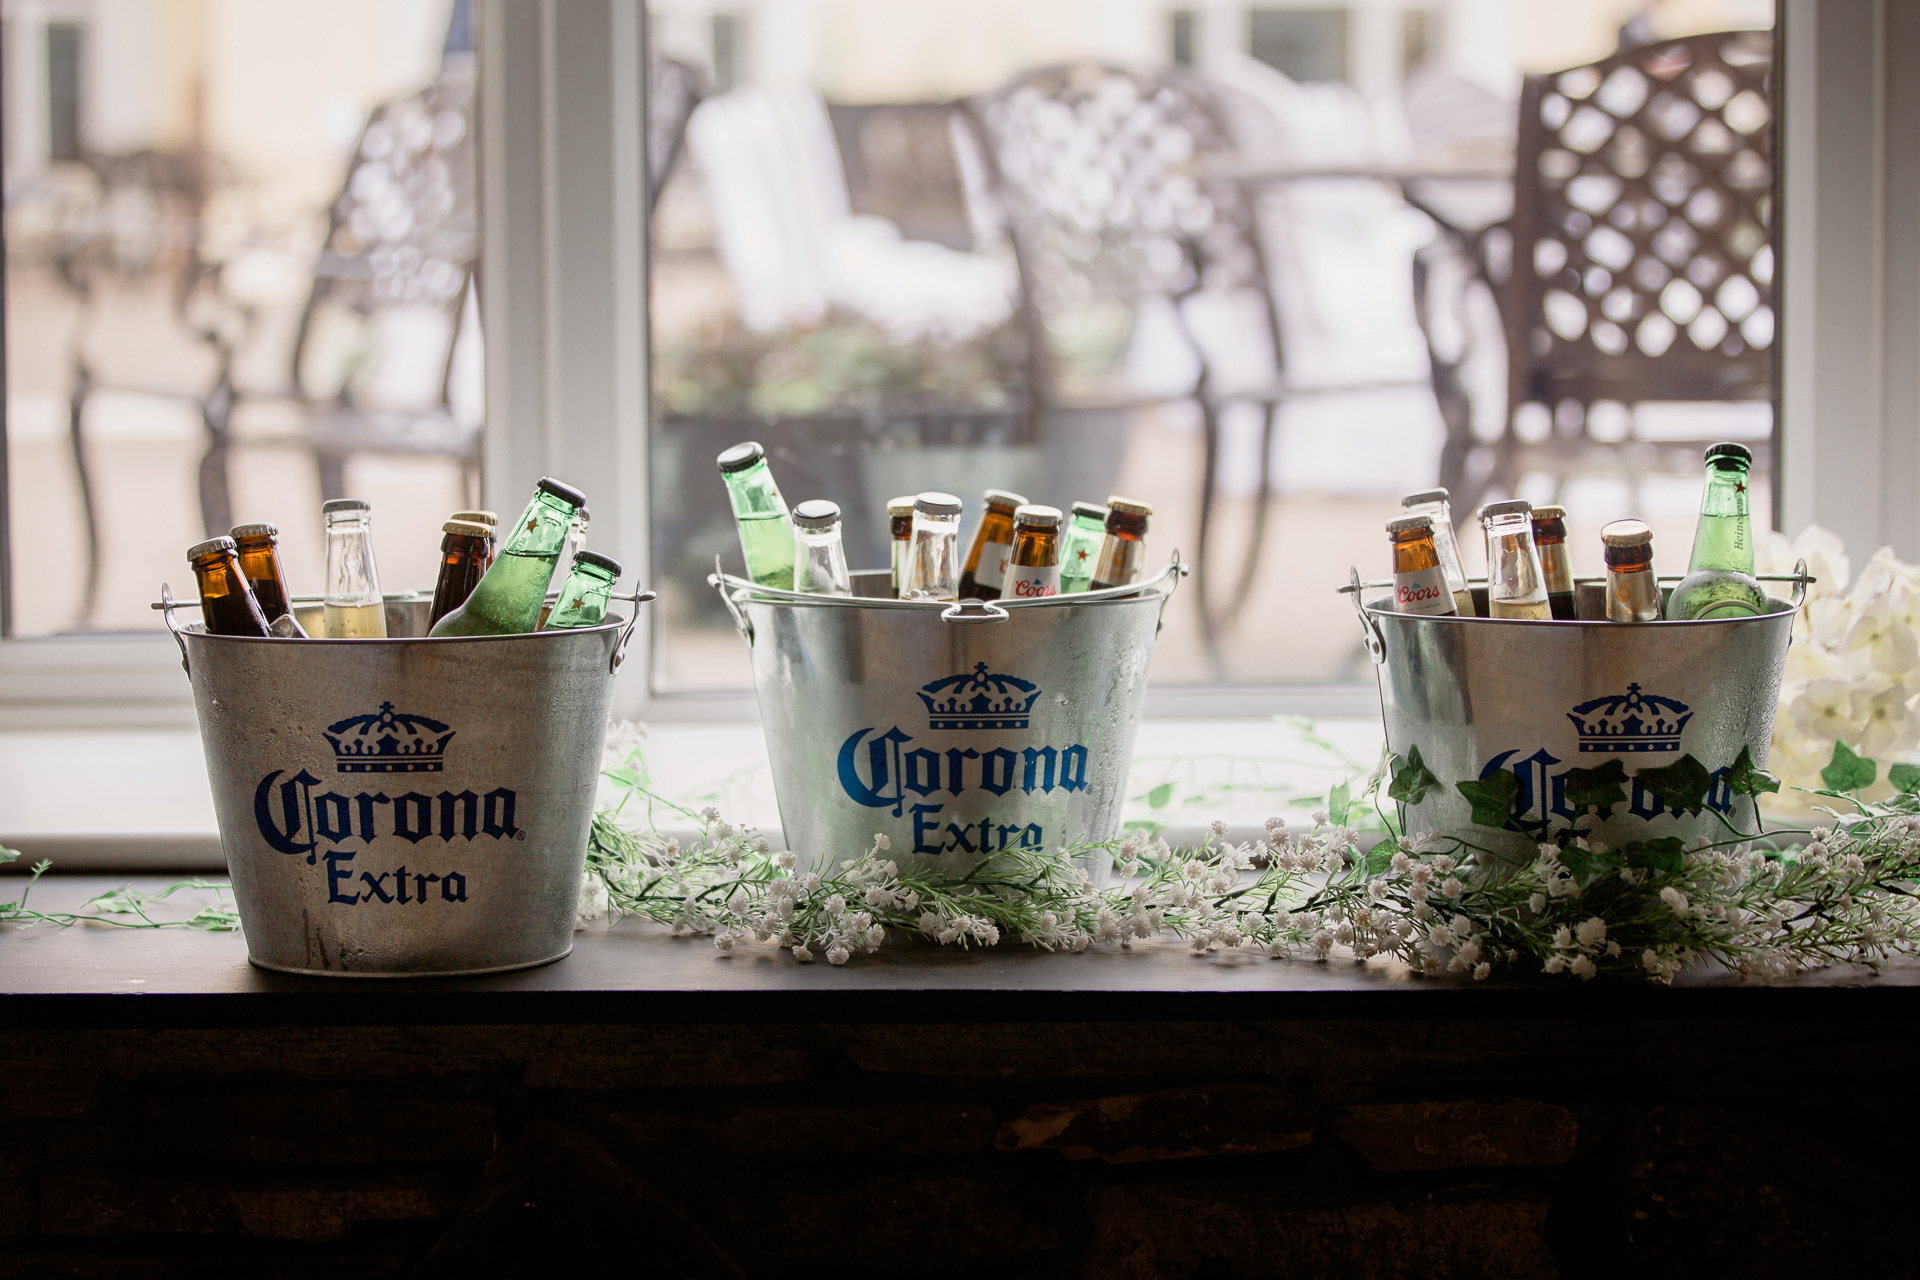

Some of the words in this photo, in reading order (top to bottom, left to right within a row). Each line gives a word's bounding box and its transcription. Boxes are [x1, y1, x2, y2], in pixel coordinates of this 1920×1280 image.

[1015, 579, 1057, 598] Coors
[1397, 584, 1441, 604] Coors
[836, 725, 1090, 818] Corona
[254, 768, 519, 866] Corona
[908, 802, 1045, 856] Extra
[322, 850, 470, 906] Extra
